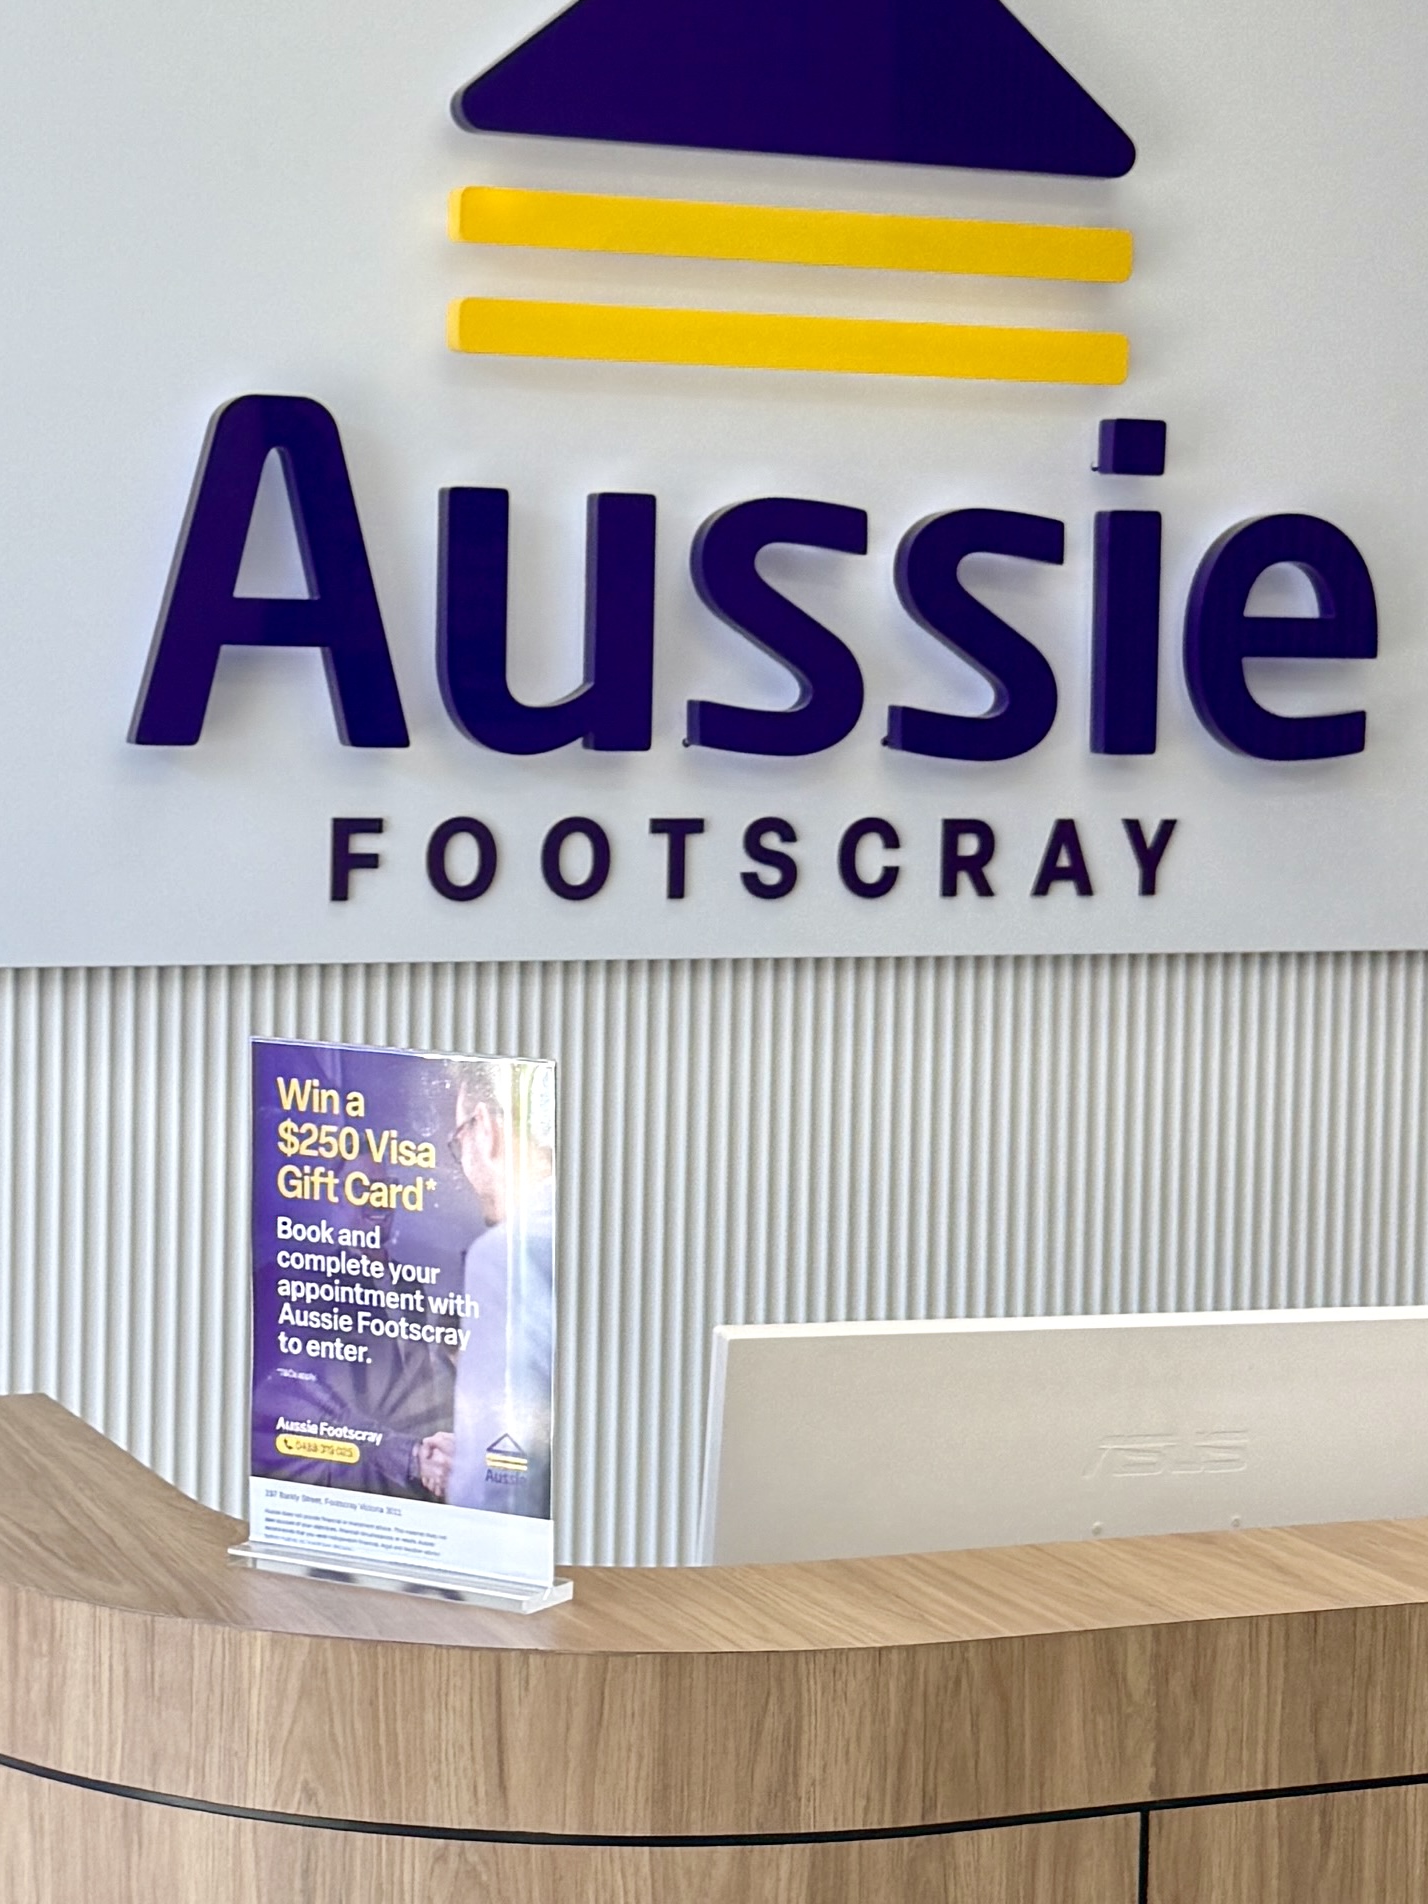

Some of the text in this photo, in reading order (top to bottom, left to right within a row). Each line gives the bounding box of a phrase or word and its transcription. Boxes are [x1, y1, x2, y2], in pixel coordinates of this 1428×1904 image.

[125, 393, 1378, 762] Aussie
[328, 816, 1178, 902] FOOTSCRAY
[277, 1076, 365, 1117] Win a
[277, 1118, 436, 1169] $250 Visa
[277, 1164, 339, 1203] Gift
[276, 1216, 381, 1249] Book and
[277, 1250, 441, 1285] complete your
[277, 1278, 480, 1319] appointment with
[278, 1302, 471, 1351] Aussie Footscray
[278, 1331, 372, 1364] to enter.
[276, 1416, 383, 1446] Aussie Footscray
